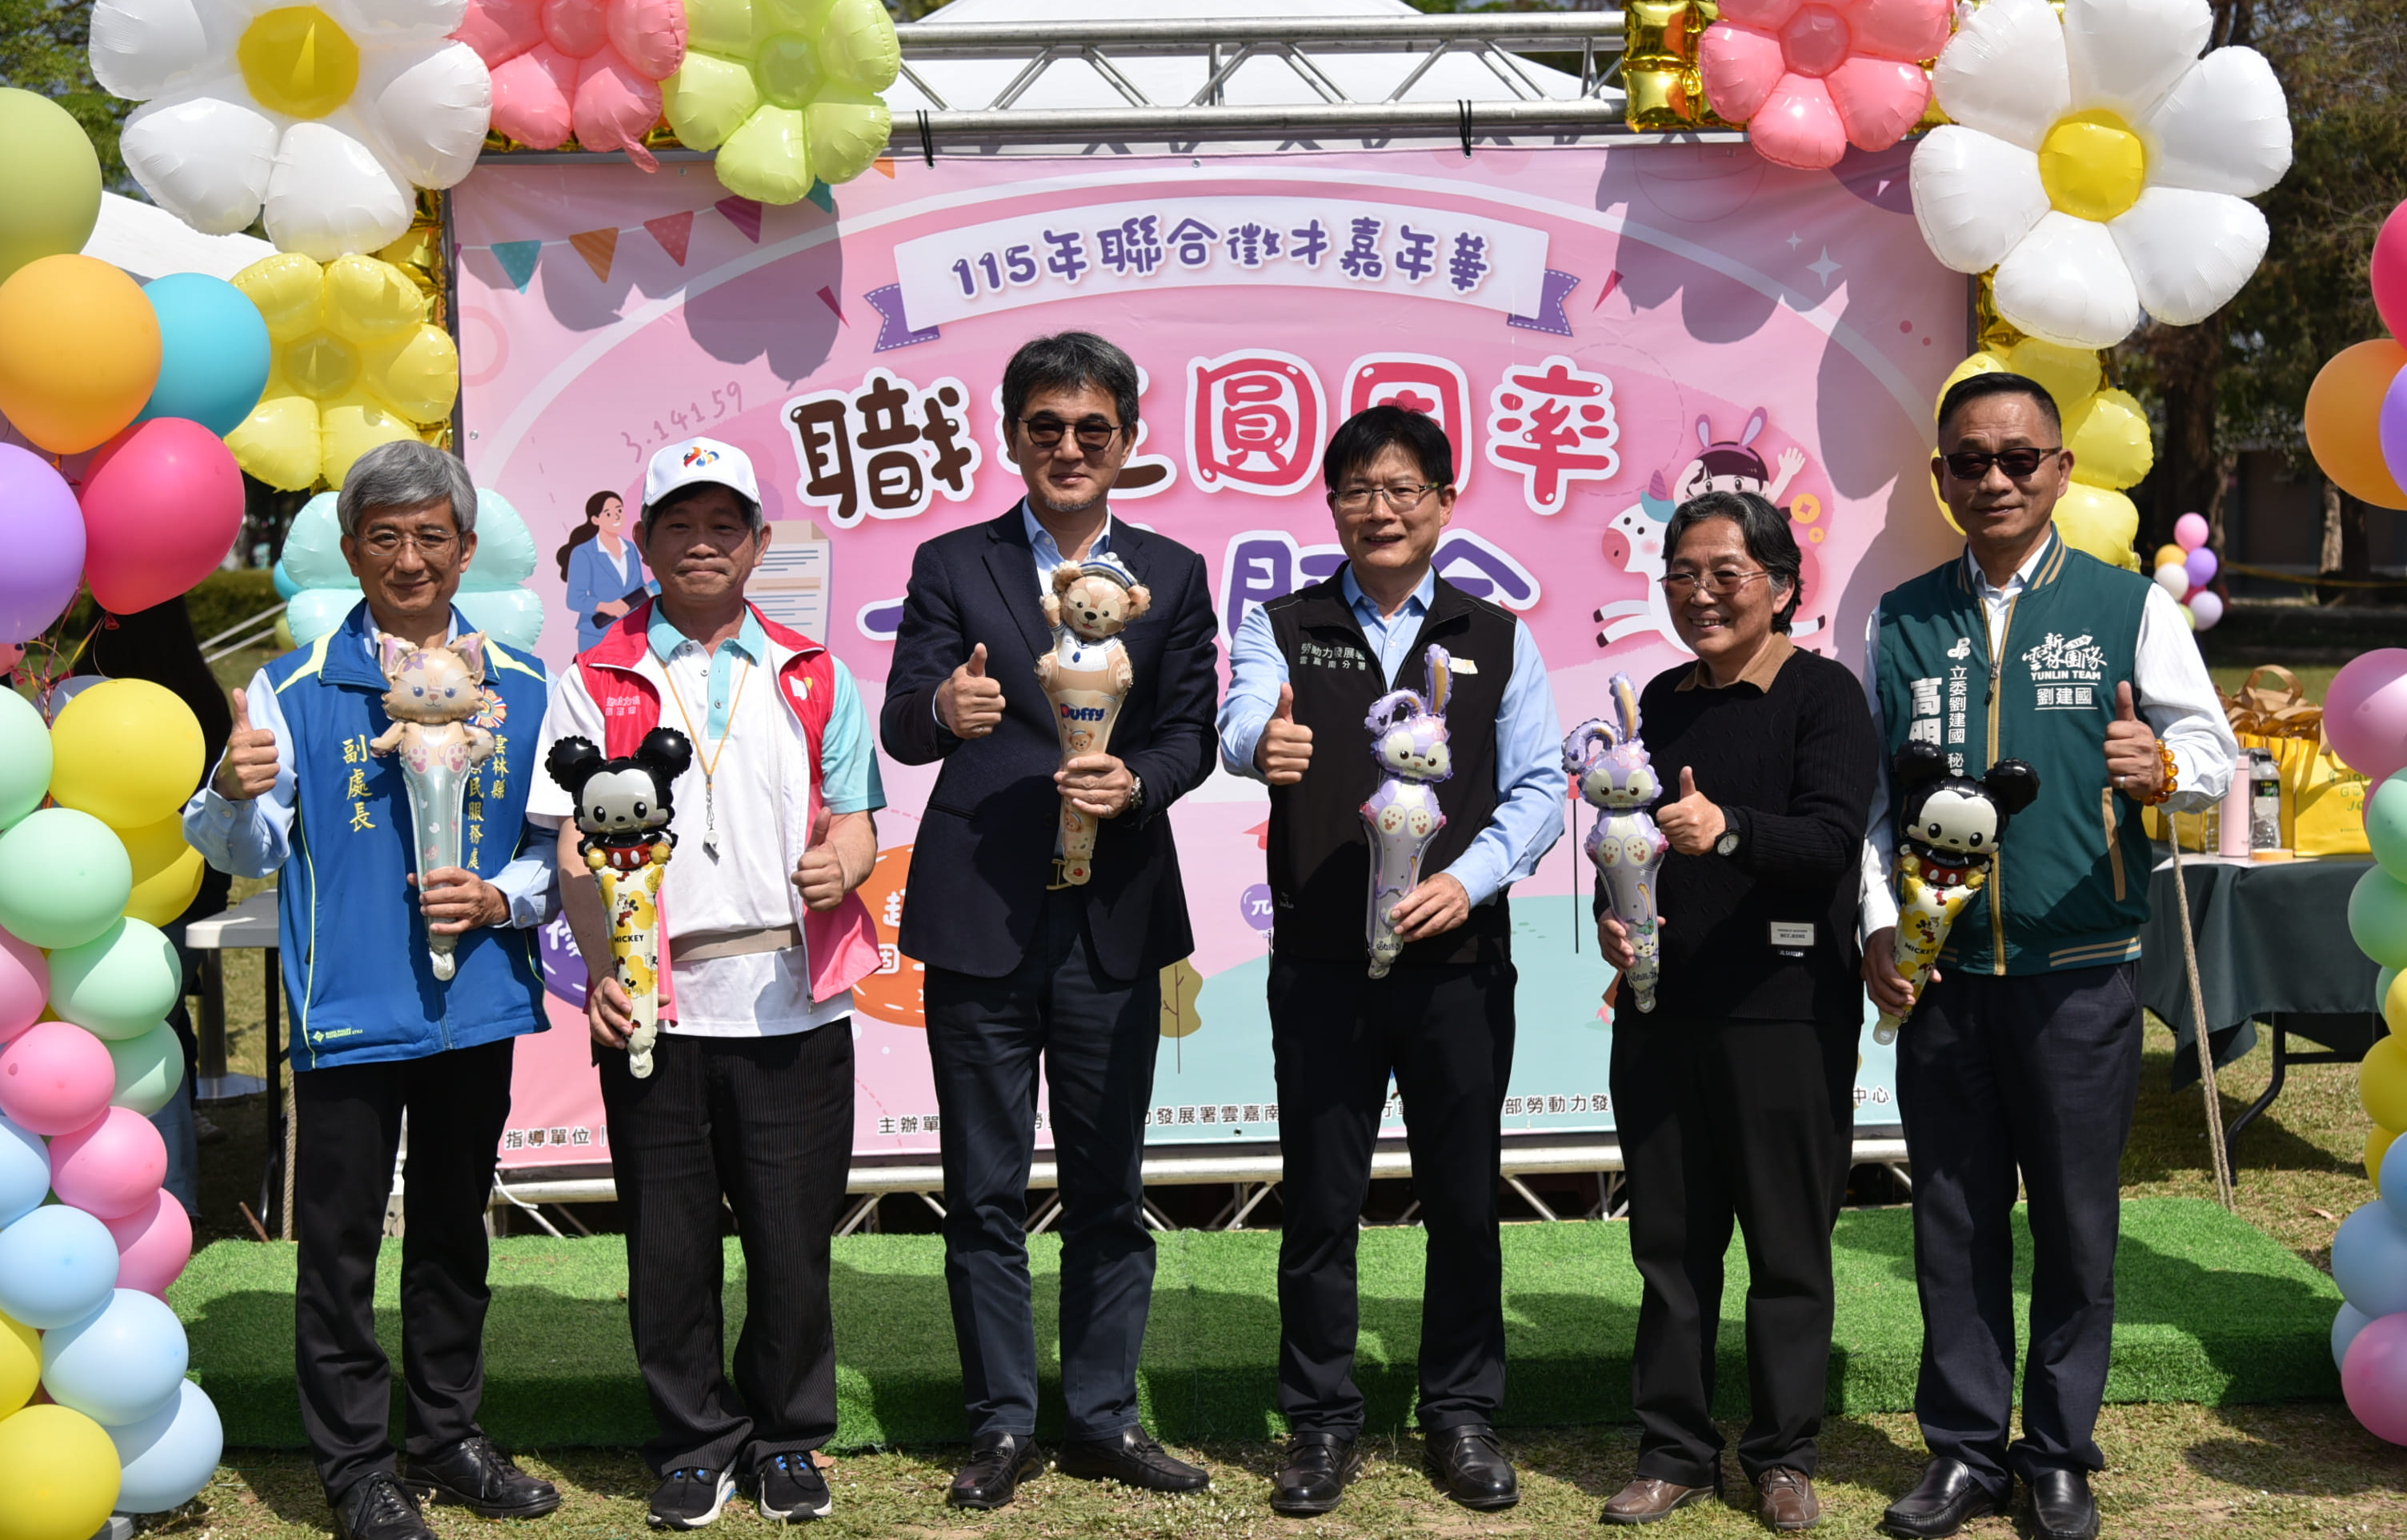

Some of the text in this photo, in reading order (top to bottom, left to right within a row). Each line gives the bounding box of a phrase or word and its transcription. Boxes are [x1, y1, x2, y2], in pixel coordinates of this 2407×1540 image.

[952, 214, 1488, 296] 115年聯合徵才嘉年華
[621, 381, 742, 463] 3.14159
[1948, 665, 1968, 744] 立委劉建國
[2031, 670, 2101, 681] YUNLIN TEAM
[2037, 687, 2092, 706] 劉建國
[342, 734, 376, 832] 副處長
[491, 734, 510, 799] 雲林縣
[467, 761, 486, 870] 民服務處
[615, 934, 644, 942] MICKEY
[1904, 942, 1935, 954] MICKEY
[506, 1128, 590, 1149] 指導單位
[879, 1116, 939, 1134] 主辦單
[1504, 1094, 1608, 1114] 部勞動力發
[1852, 1087, 1889, 1104] 中心
